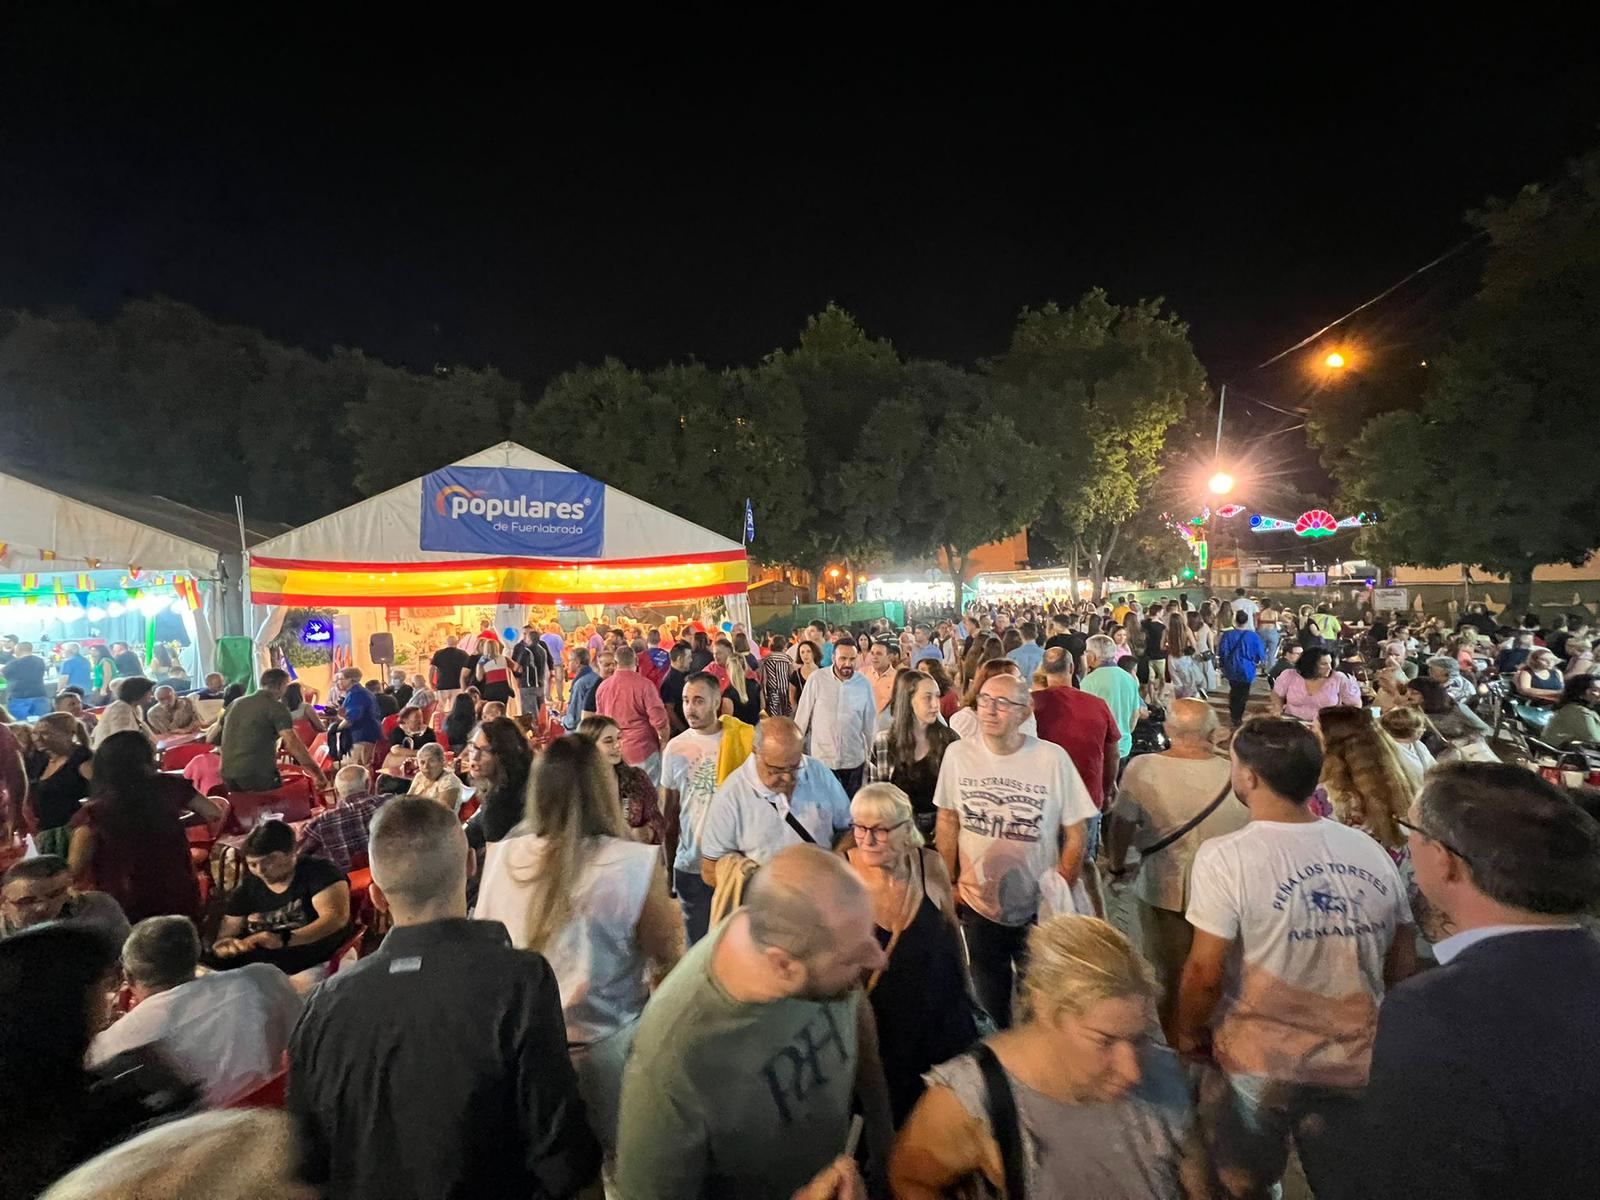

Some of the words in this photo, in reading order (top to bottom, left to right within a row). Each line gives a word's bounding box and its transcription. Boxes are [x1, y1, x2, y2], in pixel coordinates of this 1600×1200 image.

[493, 522, 509, 532] de
[511, 522, 583, 534] Fuenlabrada
[980, 776, 1023, 791] STRAUSS
[1296, 863, 1324, 881] LOS
[1327, 862, 1388, 896] TORETES
